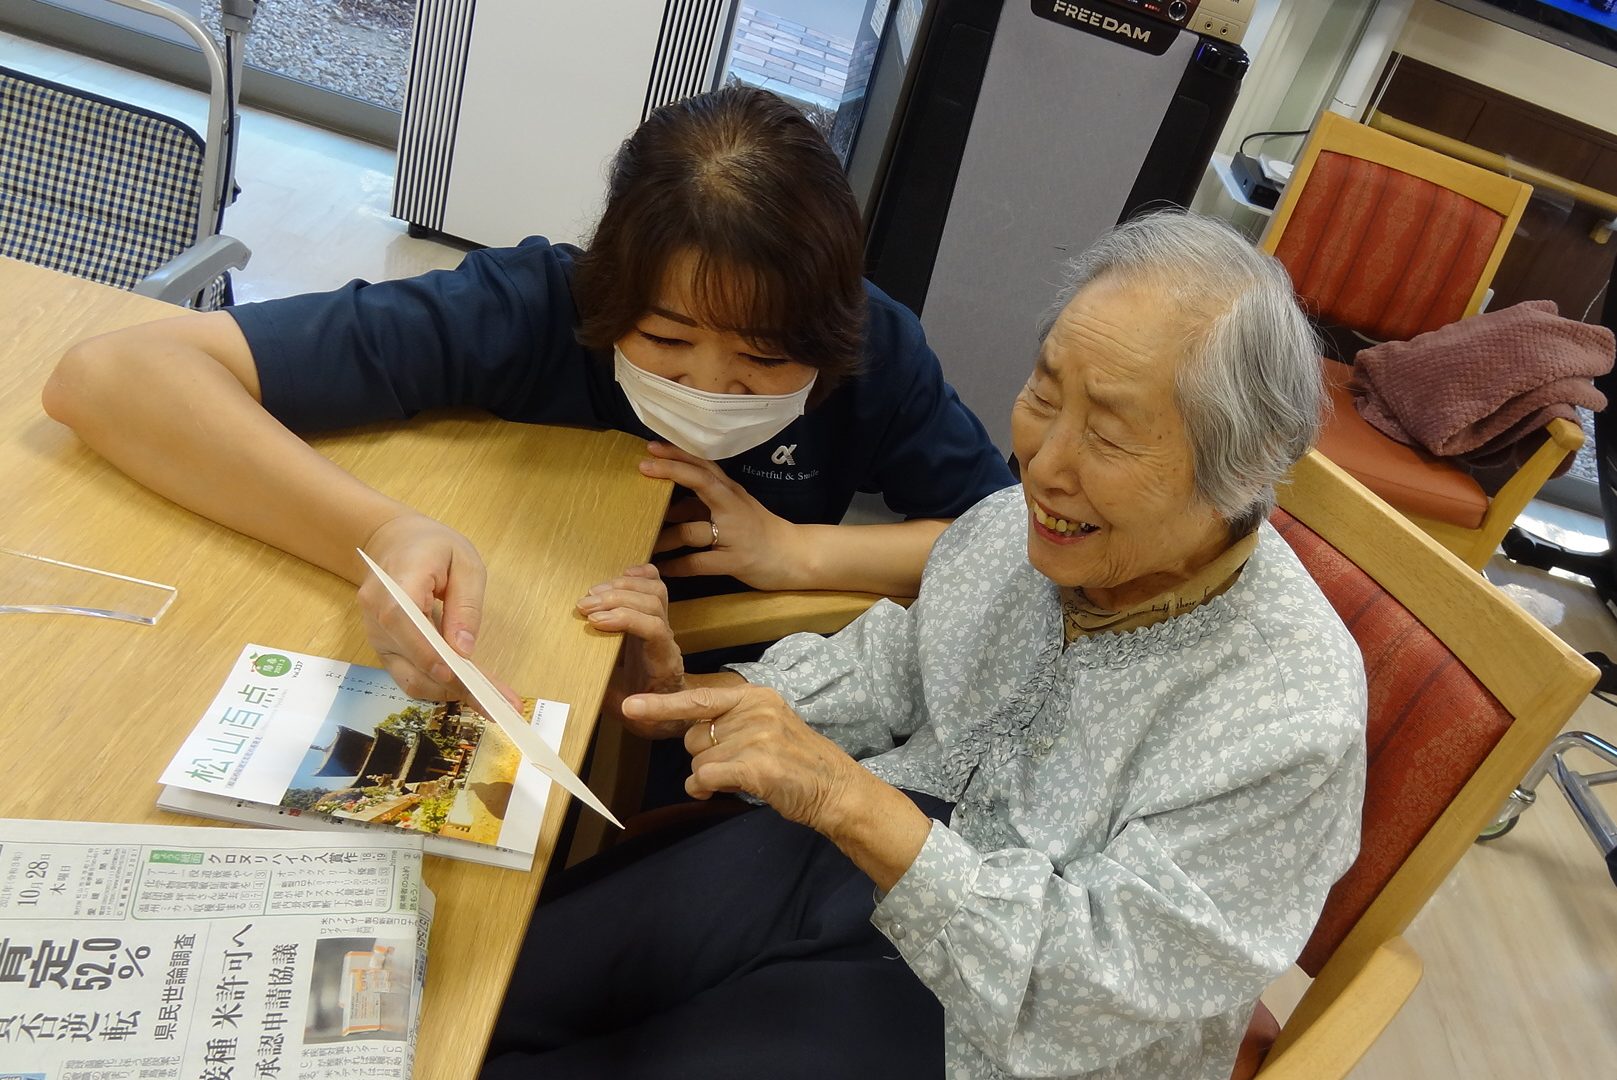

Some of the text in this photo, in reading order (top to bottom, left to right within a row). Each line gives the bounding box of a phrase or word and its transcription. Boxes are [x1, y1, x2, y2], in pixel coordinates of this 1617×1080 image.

[1053, 1, 1151, 43] FREEDAM
[742, 465, 782, 479] Heartful
[785, 472, 795, 480] &
[185, 684, 279, 783] 松山百点
[17, 853, 51, 906] 10月28日
[49, 865, 71, 895] 木曜日
[208, 851, 359, 864] クロヌリハイク入賞作
[154, 933, 197, 1041] 県民世論調査
[255, 943, 299, 1079] 承認申請協議
